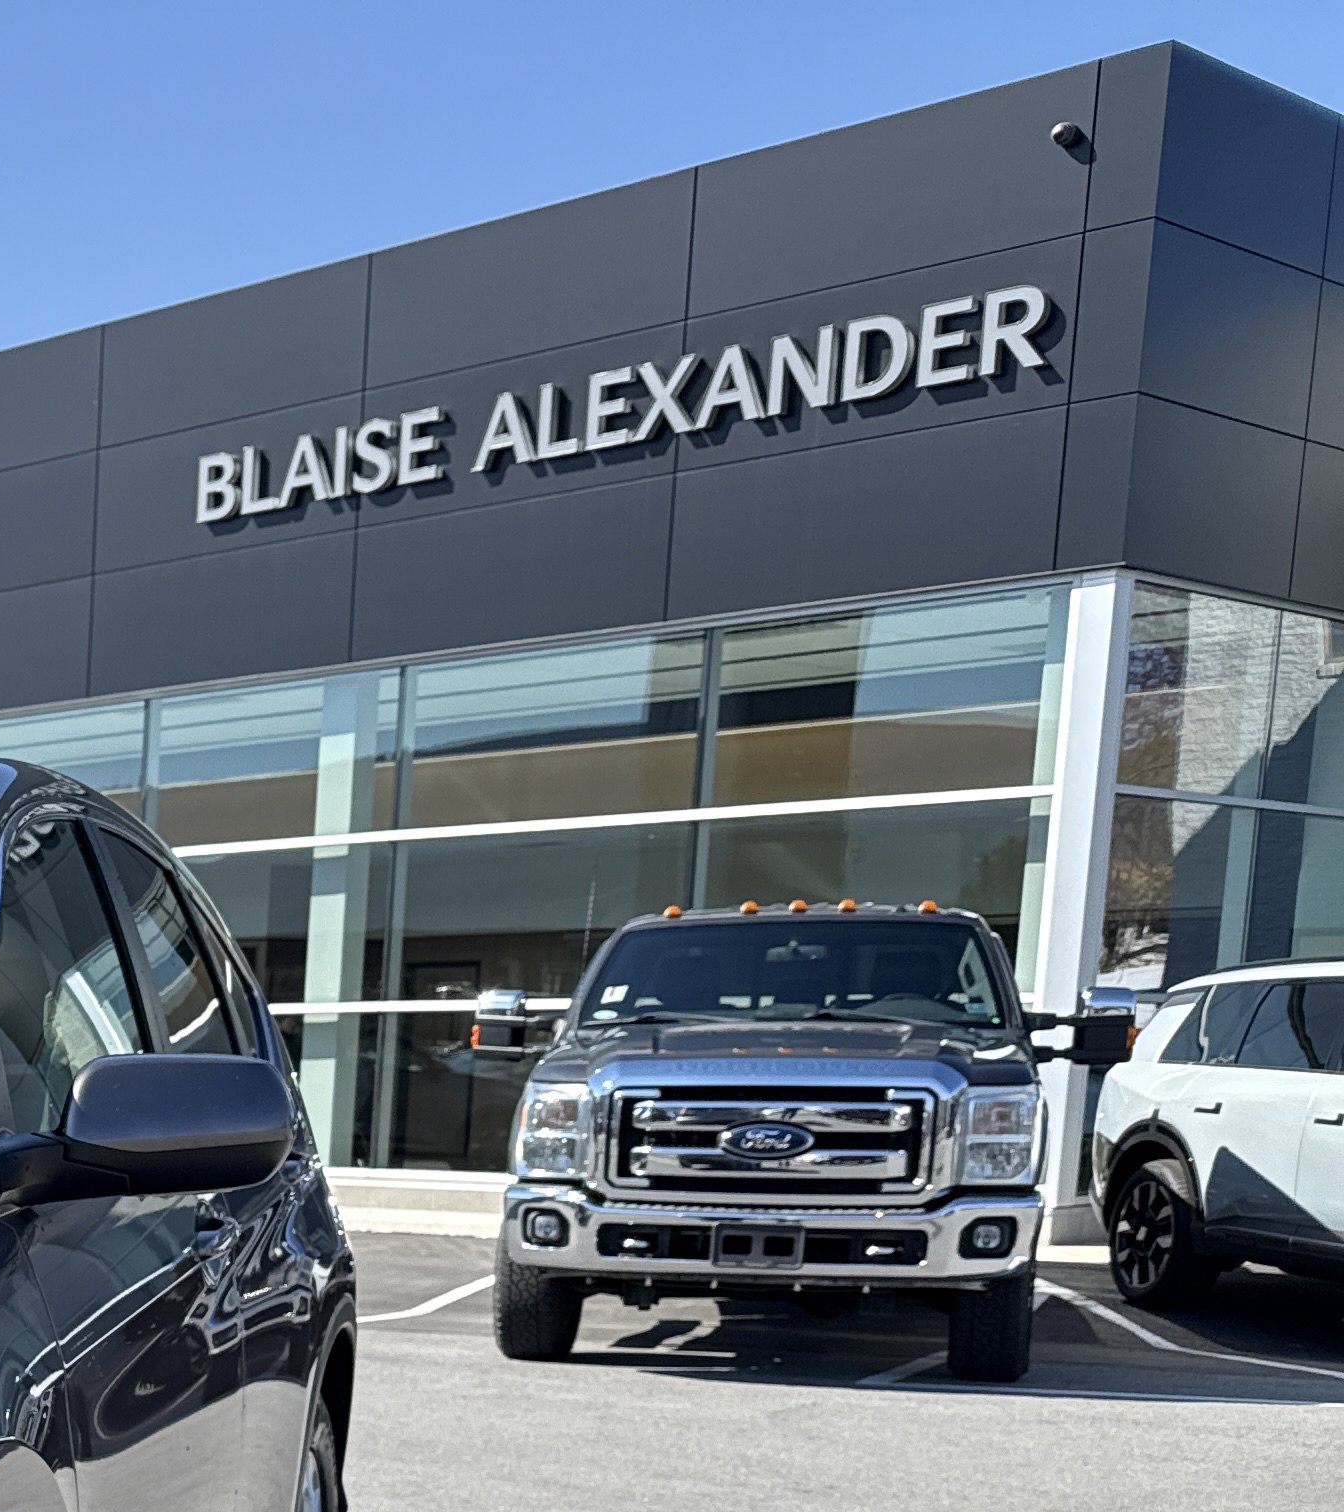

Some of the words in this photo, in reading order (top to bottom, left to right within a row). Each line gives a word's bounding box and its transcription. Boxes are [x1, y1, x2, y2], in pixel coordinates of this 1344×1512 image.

[196, 405, 445, 524] BLAISE
[470, 284, 1050, 473] ALEXANDER
[740, 1127, 792, 1149] Ford
